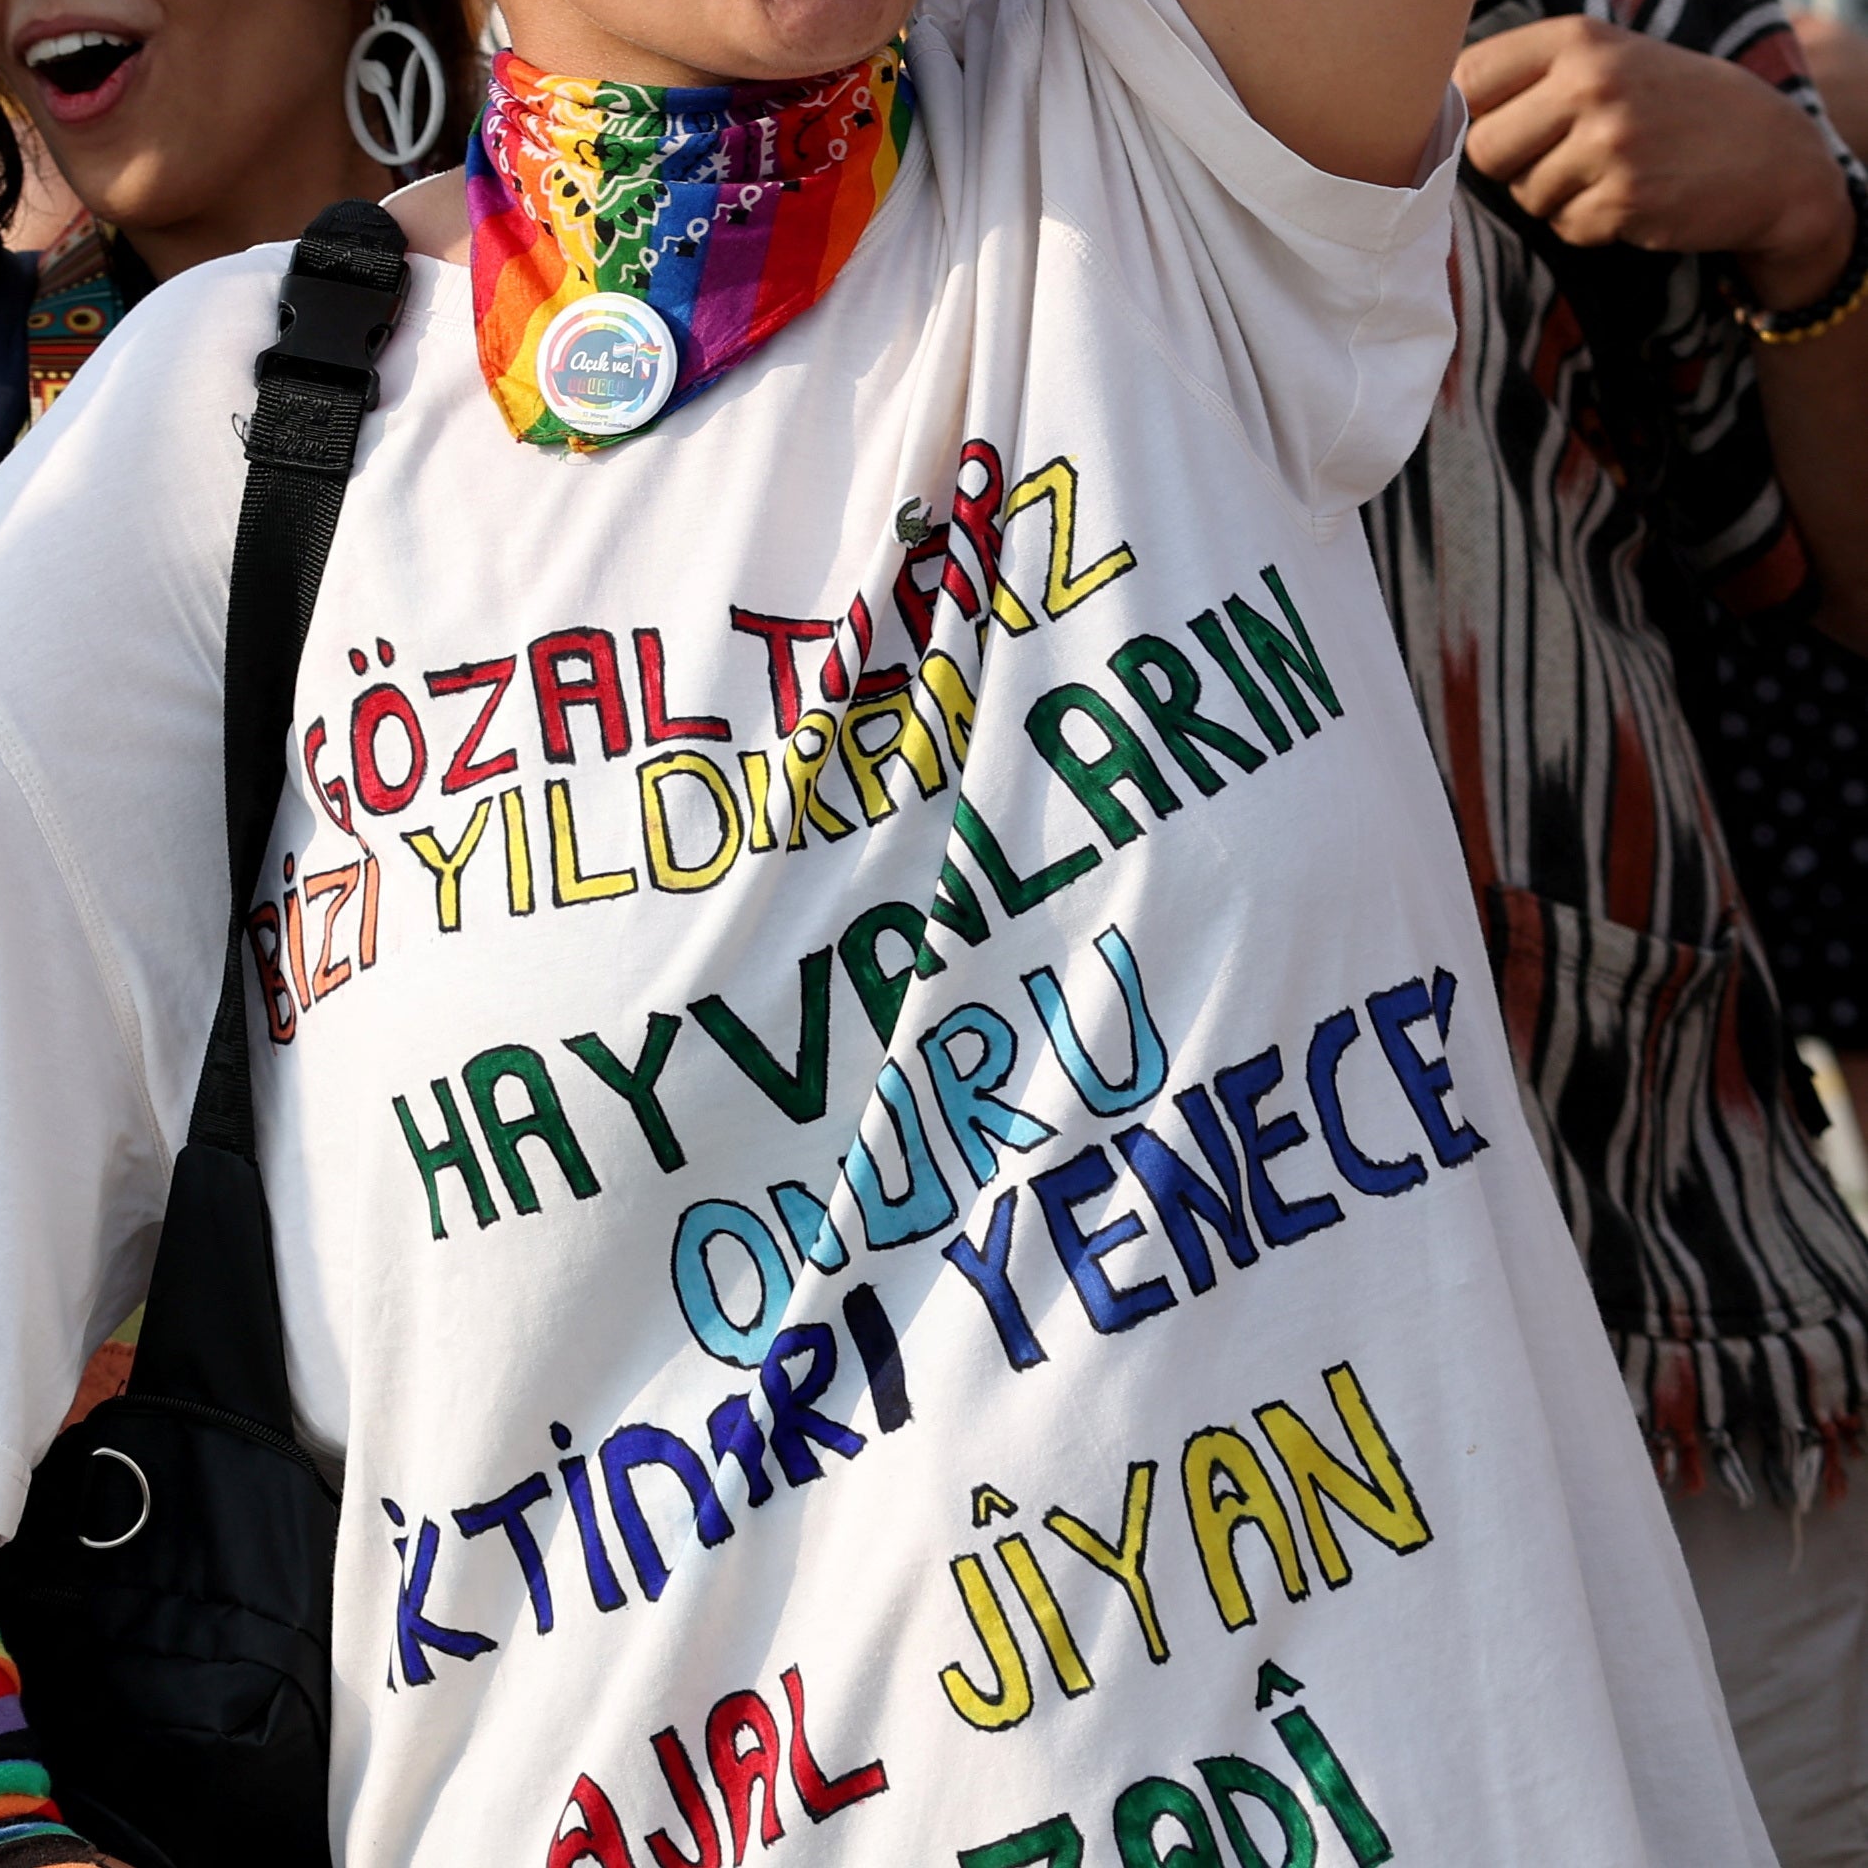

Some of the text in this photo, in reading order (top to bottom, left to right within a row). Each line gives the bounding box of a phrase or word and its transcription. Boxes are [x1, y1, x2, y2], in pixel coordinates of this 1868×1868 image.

[570, 350, 632, 374] Açık ve
[670, 923, 1169, 1370] ONURU
[939, 1361, 1433, 1734] JÎYAN
